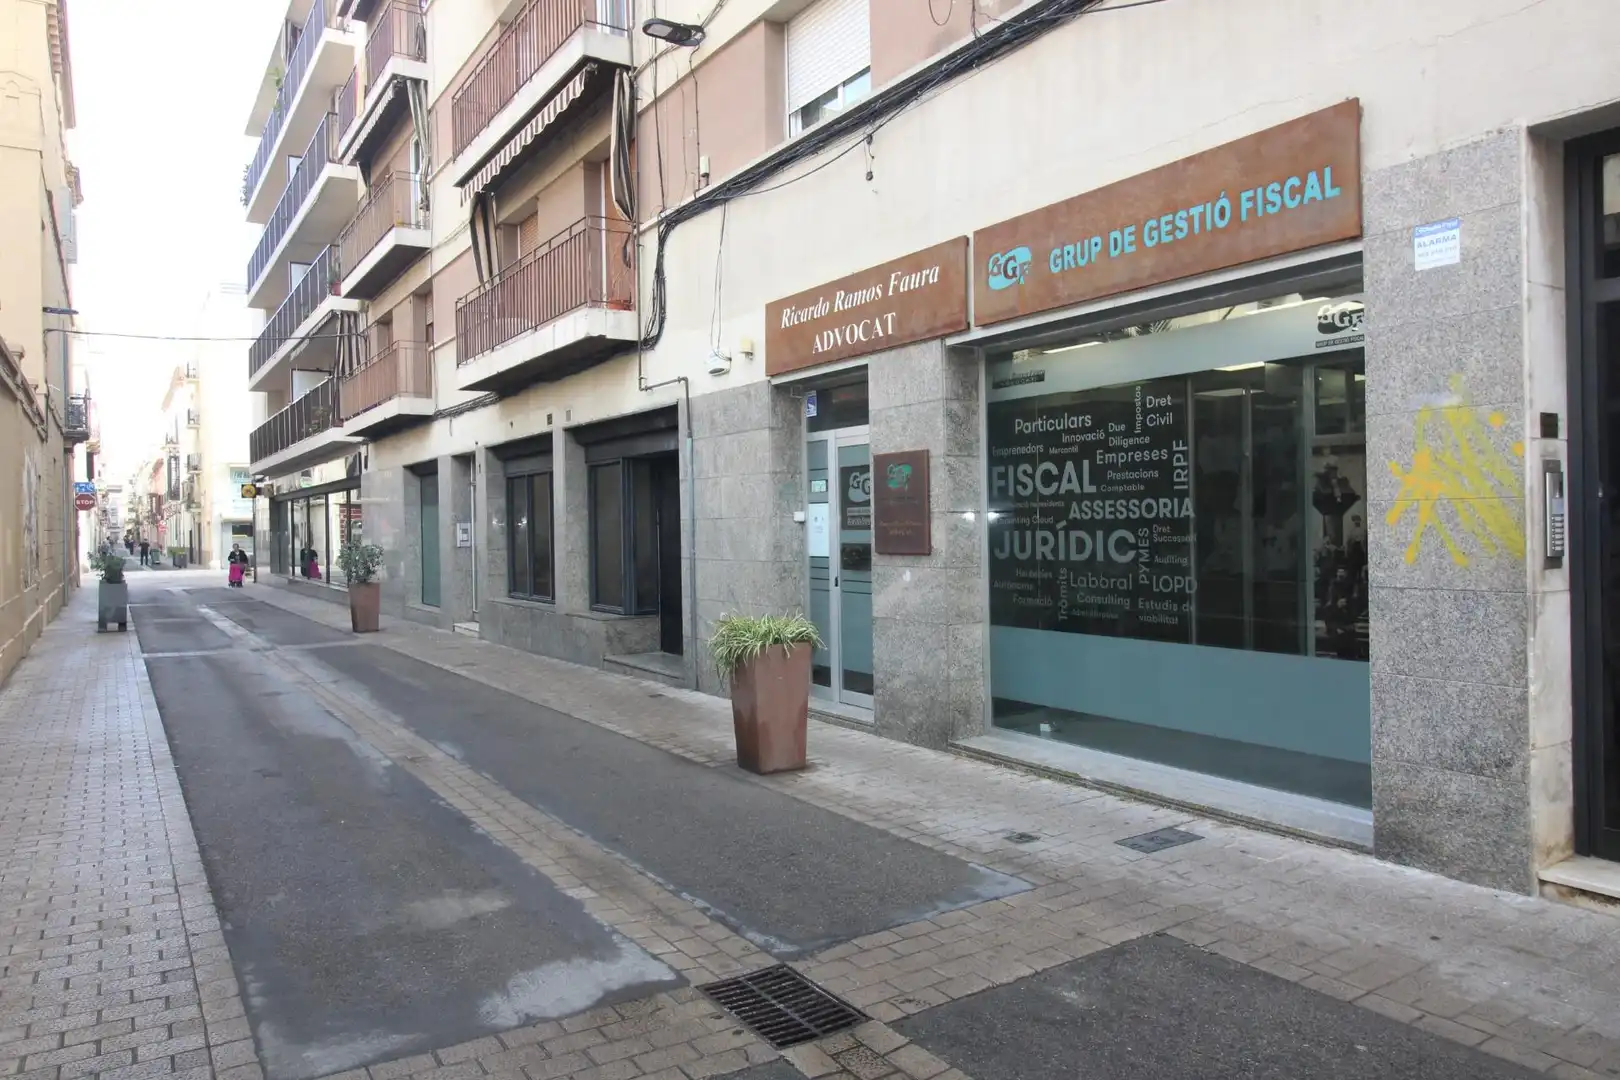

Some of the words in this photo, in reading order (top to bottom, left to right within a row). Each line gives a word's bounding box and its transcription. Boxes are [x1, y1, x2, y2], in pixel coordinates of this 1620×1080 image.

[1049, 236, 1102, 274] GRUP
[1108, 225, 1137, 258] DE
[1143, 191, 1231, 248] GESTIÓ
[1240, 165, 1341, 222] FISCAL
[780, 298, 830, 329] Ricardo
[833, 283, 883, 313] Ramos
[888, 264, 940, 296] Faura
[812, 312, 896, 354] ADVOCAT
[1146, 394, 1172, 408] Dret
[1015, 412, 1092, 434] Particulars
[1108, 422, 1126, 432] Due
[1146, 412, 1173, 427] Civil
[1062, 429, 1105, 443] Innovació
[1108, 435, 1150, 448] Diligence
[992, 443, 1044, 458] Emprenedors
[1049, 445, 1079, 455] Mercantil
[1096, 448, 1168, 467] Empreses
[1173, 439, 1189, 490] IRPF
[991, 459, 1097, 498] FISCAL
[1107, 468, 1159, 480] Prestacions
[1100, 483, 1145, 493] Comptable
[1069, 497, 1195, 519] ASSESSORIA
[993, 519, 1137, 564] JURÍDIC
[1138, 527, 1150, 585] PYMES
[1154, 555, 1188, 567] Auditing
[1070, 571, 1133, 591] Laboral
[1152, 575, 1198, 594] LOPD
[1076, 592, 1131, 609] Consulting
[1138, 597, 1178, 612] Estudis
